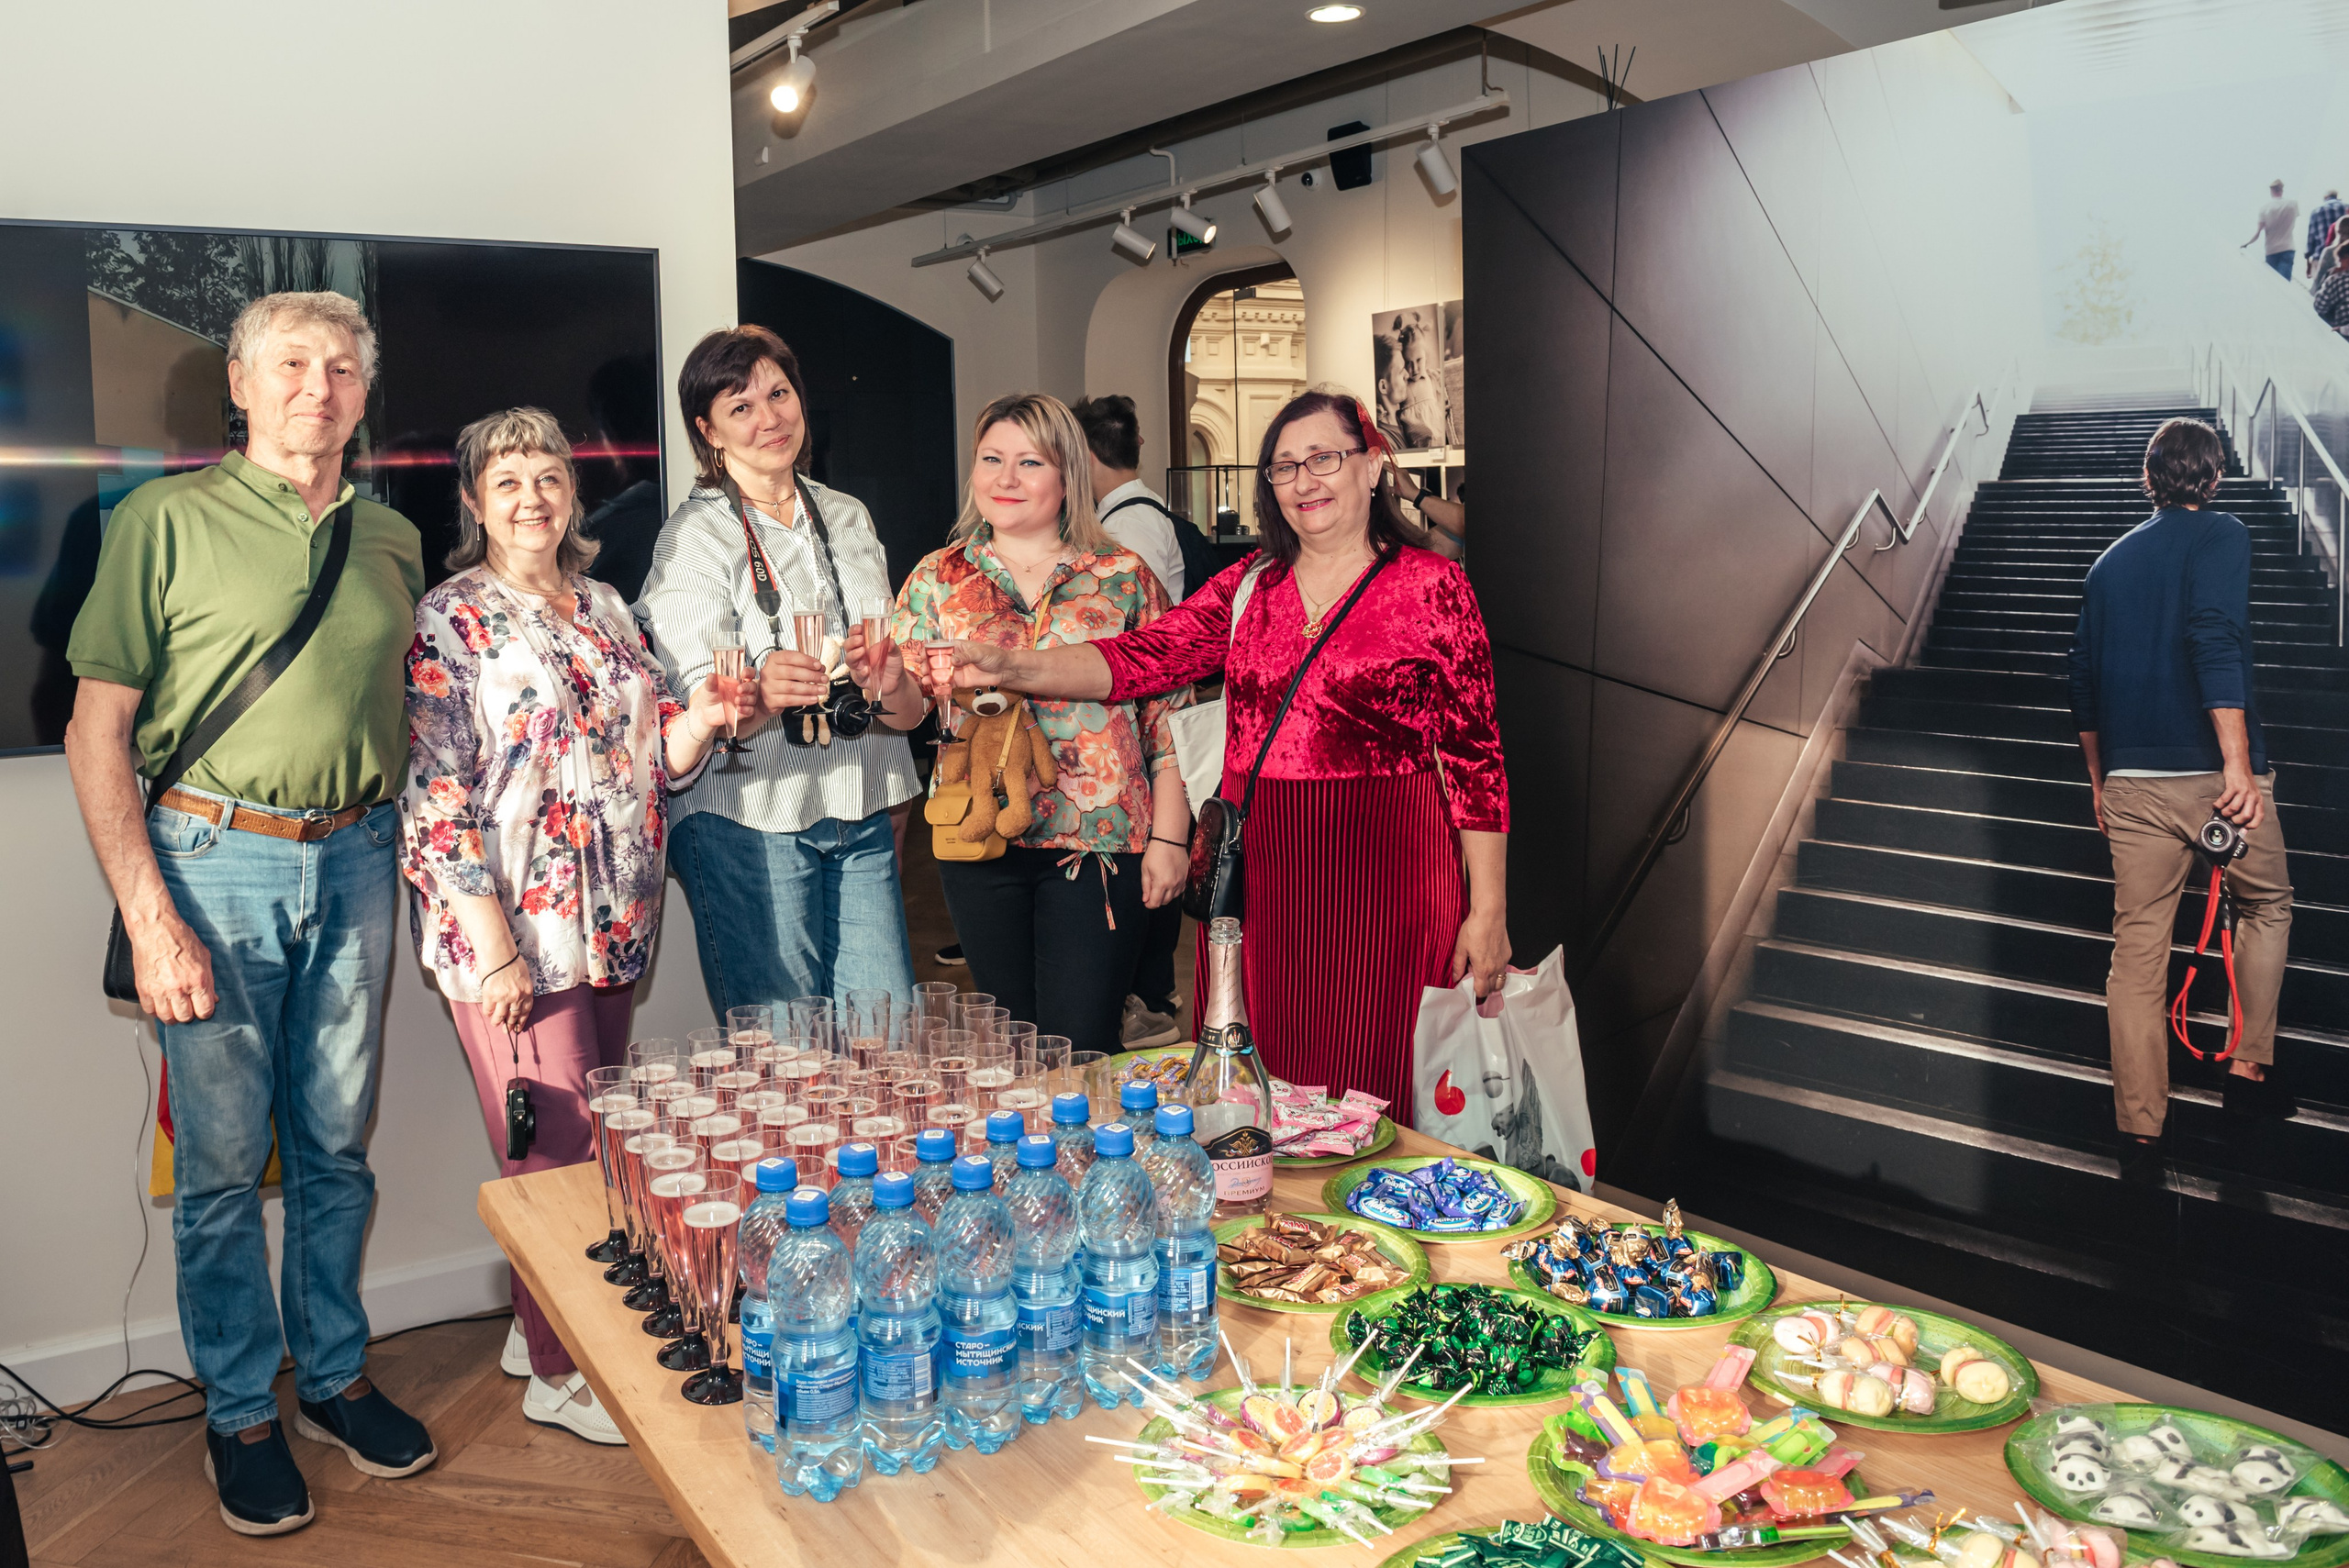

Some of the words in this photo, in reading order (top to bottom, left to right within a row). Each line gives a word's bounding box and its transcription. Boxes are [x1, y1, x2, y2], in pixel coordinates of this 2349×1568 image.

[754, 561, 768, 582] 60D
[2232, 841, 2245, 857] LEICA
[1211, 1156, 1274, 1172] ОССИЙСКО
[1223, 1185, 1266, 1196] ПРЕМИУМ
[955, 1355, 1004, 1367] ИСТОЧНИК
